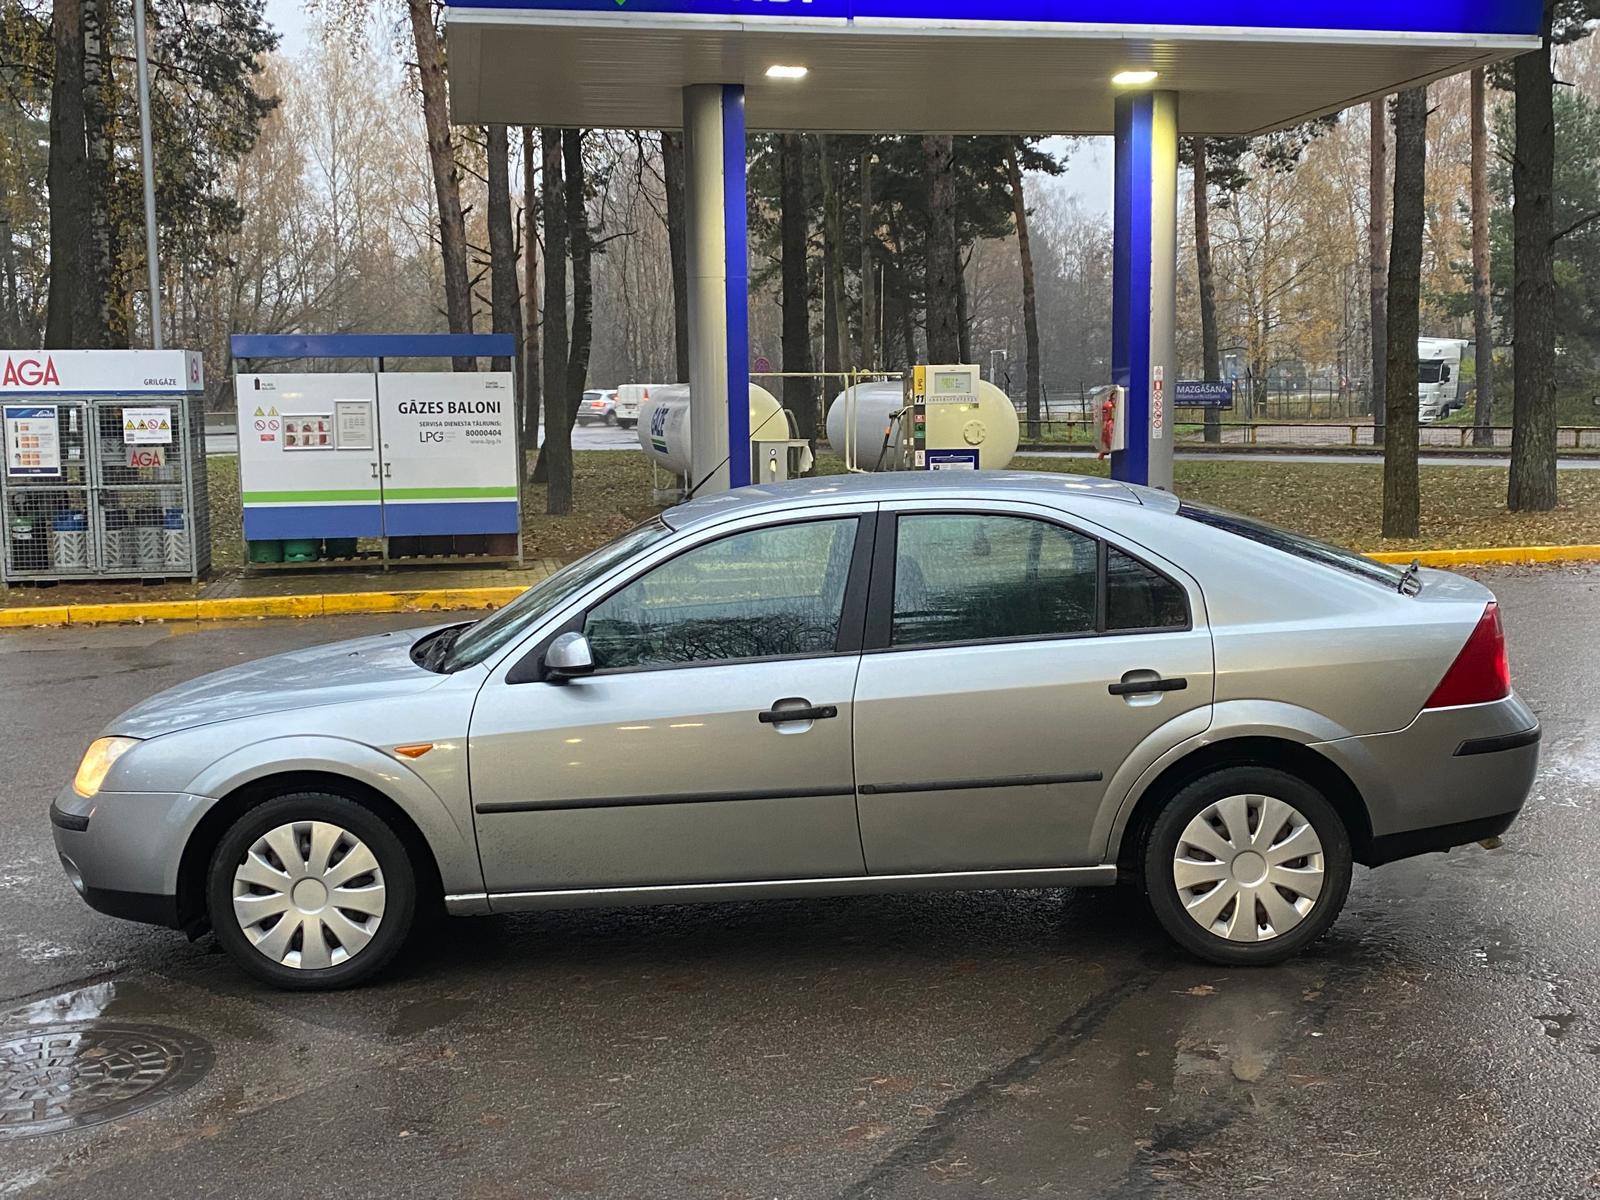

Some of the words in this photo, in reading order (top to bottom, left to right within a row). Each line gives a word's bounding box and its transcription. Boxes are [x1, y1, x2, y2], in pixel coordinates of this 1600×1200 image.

[3, 355, 60, 386] AGA
[398, 399, 444, 414] GĀZES
[448, 401, 501, 414] BALONI
[915, 395, 924, 403] 11
[131, 449, 160, 466] AGA
